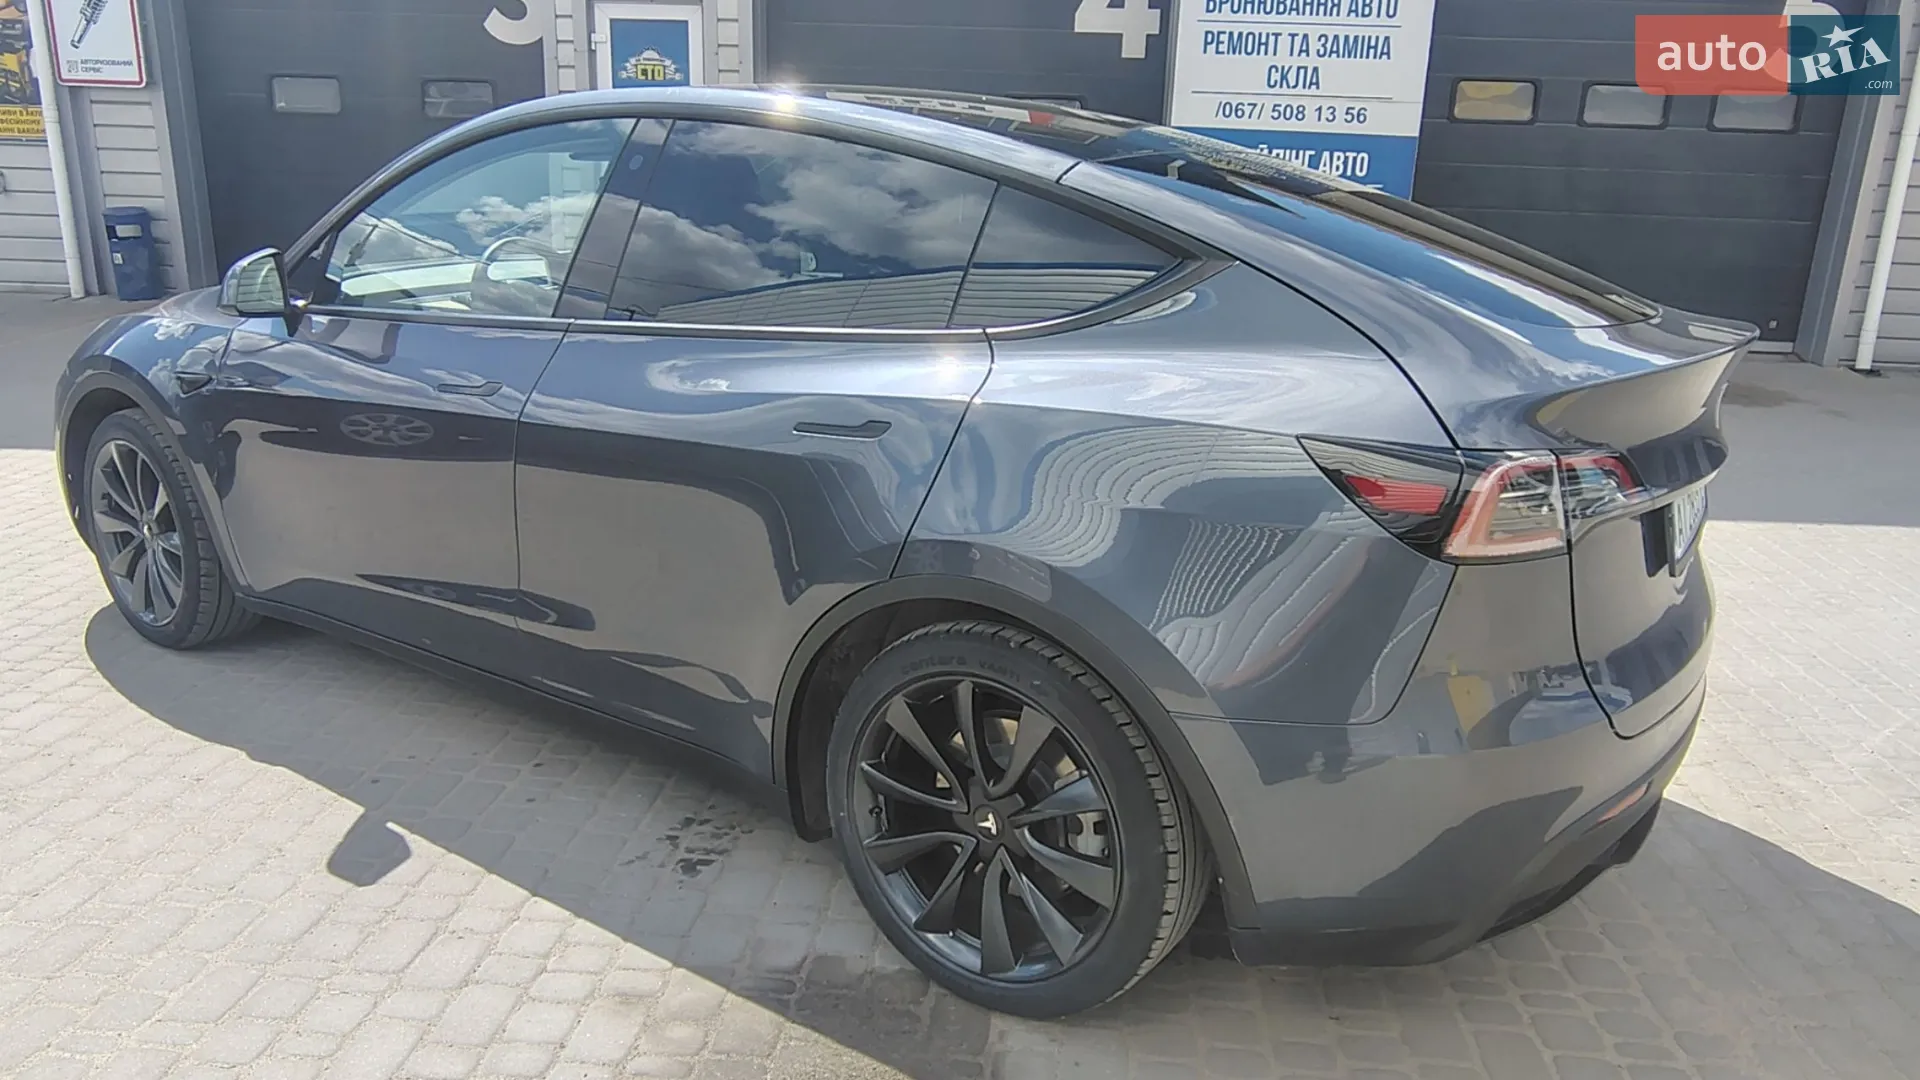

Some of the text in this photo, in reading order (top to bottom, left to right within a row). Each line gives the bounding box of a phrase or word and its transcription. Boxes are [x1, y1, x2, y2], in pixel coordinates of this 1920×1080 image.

[1205, 0, 1399, 19] БРОНЮВАННЯ АВТО
[1203, 30, 1391, 60] РЕМОНТ ТА ЗАМІНА
[637, 64, 664, 80] СТО
[1266, 65, 1320, 90] СКЛА
[1214, 101, 1368, 124] /067/ 508 13 56
[1318, 151, 1369, 177] АВТО
